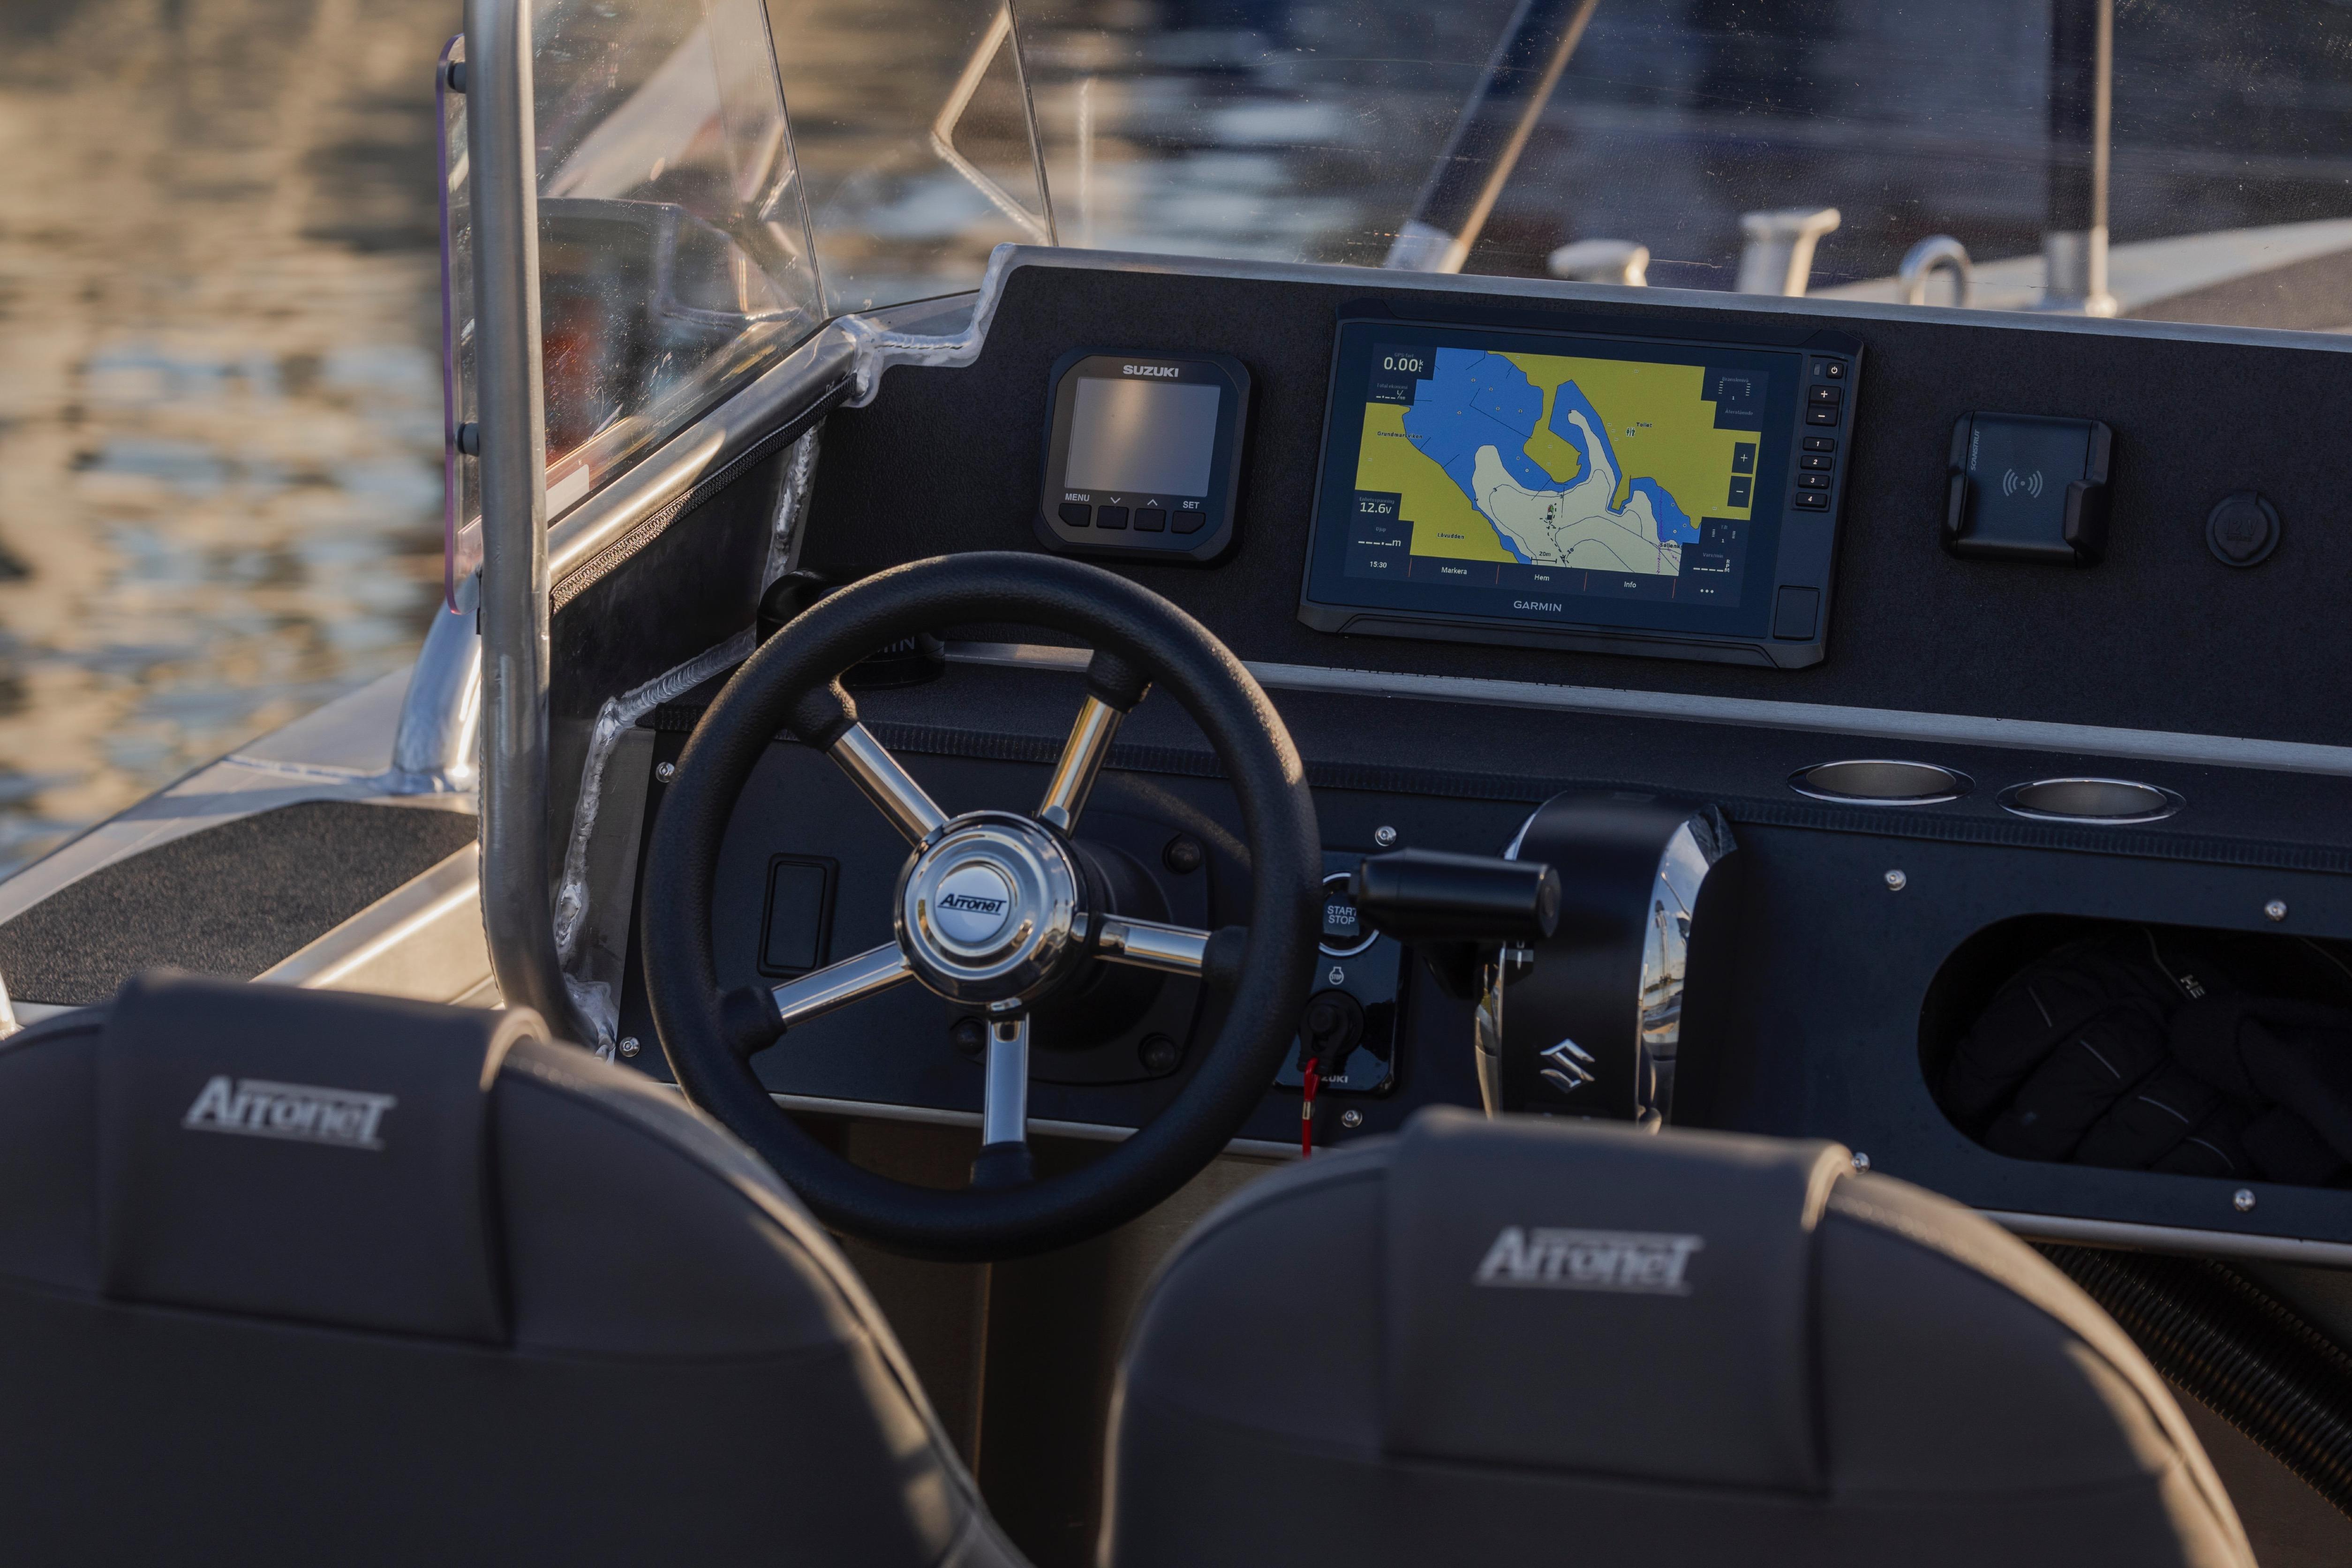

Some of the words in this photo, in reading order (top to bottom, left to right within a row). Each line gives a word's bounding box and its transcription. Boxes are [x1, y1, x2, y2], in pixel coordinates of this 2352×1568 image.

[1384, 357, 1418, 372] 0.00
[1123, 365, 1179, 377] SUZUKI
[1971, 429, 1981, 471] SCANSTRUT
[1065, 493, 1090, 502] MENU
[1183, 501, 1199, 509] SET
[1441, 566, 1468, 575] Markera
[1513, 600, 1562, 612] GARMIN
[1328, 914, 1355, 925] STOP
